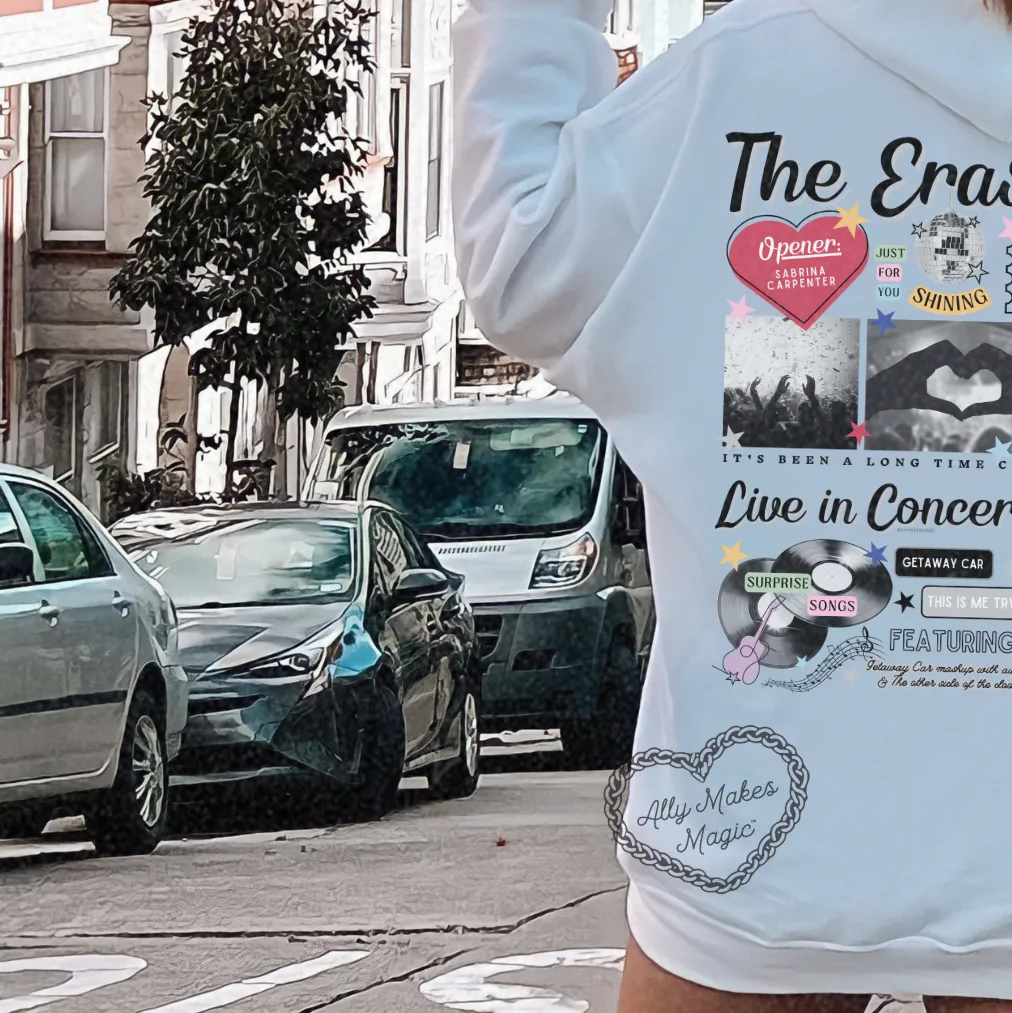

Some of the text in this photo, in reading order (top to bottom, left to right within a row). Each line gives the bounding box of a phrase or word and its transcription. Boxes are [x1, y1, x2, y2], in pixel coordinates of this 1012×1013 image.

[725, 131, 848, 213] The
[758, 236, 842, 265] Opener:
[875, 247, 906, 259] JUST
[775, 266, 827, 280] SABRINA
[878, 267, 900, 278] FOR
[767, 276, 836, 291] CARPENTER
[877, 286, 900, 298] YOU
[912, 287, 988, 312] SHINING
[722, 453, 765, 464] IT'S
[778, 454, 829, 465] BEEN
[842, 456, 853, 466] A
[866, 457, 920, 468] LONG
[934, 458, 985, 469] TIME
[714, 479, 807, 529] Live
[818, 489, 858, 525] in
[902, 556, 984, 570] GETAWAY CAR
[746, 576, 809, 590] SURPRISE
[809, 599, 856, 612] SONGS
[927, 595, 952, 608] THIS
[956, 596, 966, 608] IS
[971, 597, 989, 609] ME
[866, 659, 909, 677] Getaway
[912, 661, 934, 673] Car
[935, 663, 974, 676] mashup
[976, 664, 999, 675] with
[891, 674, 908, 687] The
[911, 676, 936, 688] other
[938, 678, 960, 689] side
[962, 678, 975, 691] of
[977, 678, 991, 689] the
